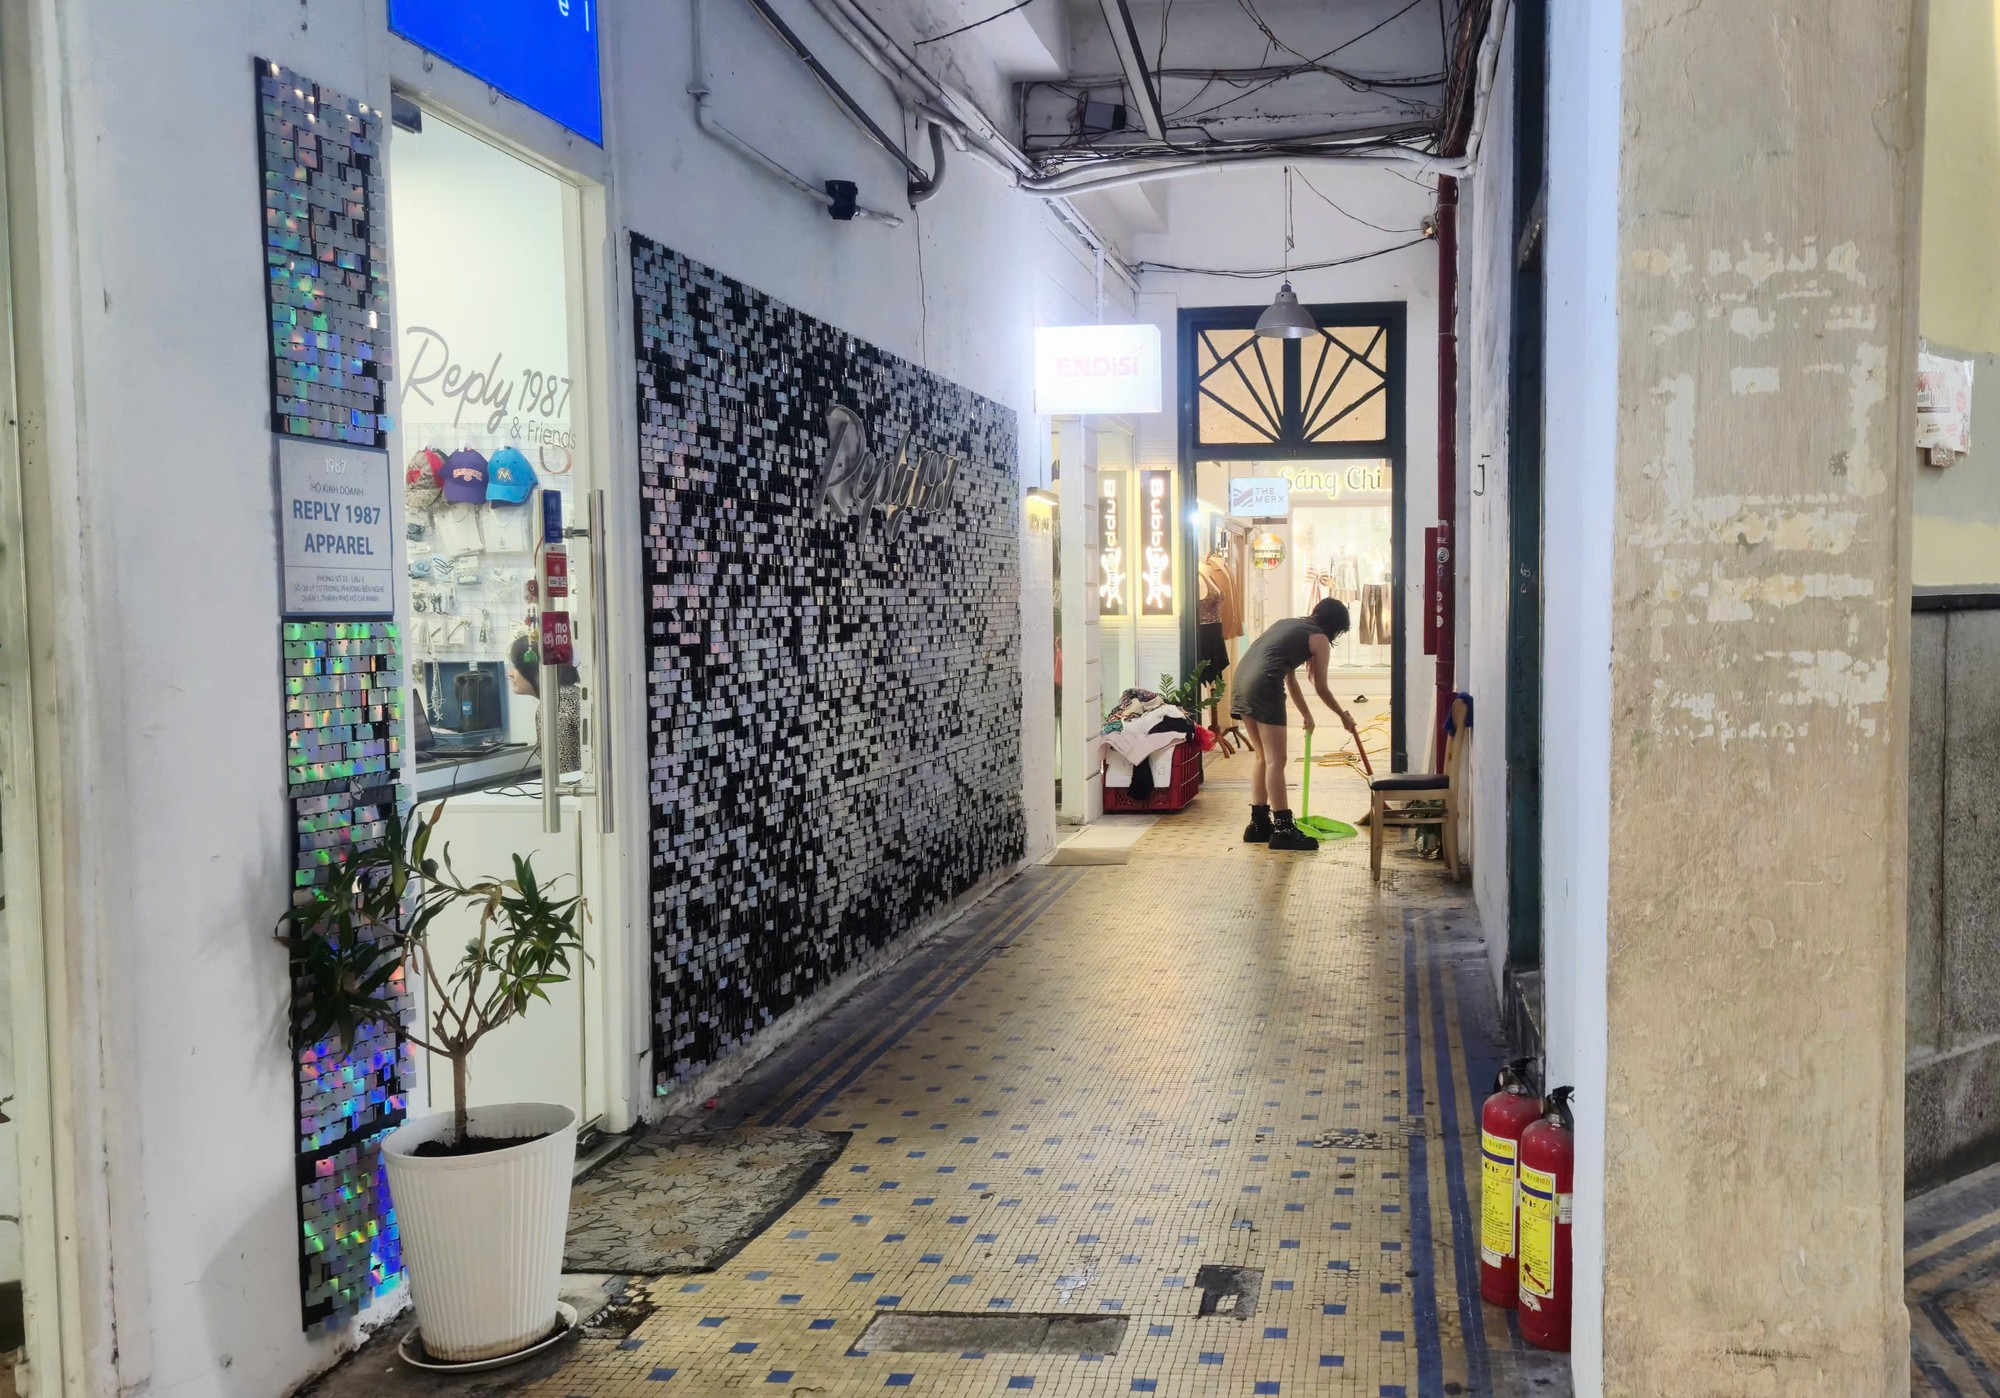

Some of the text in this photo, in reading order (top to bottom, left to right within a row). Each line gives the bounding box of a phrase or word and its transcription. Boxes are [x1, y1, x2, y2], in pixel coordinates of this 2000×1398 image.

[401, 326, 574, 434] Reply 1987
[510, 416, 576, 449] & Friends
[815, 404, 915, 545] Reply
[1281, 466, 1381, 497] Sáng Chi
[322, 483, 339, 494] KINH
[340, 485, 364, 496] DOANH
[1255, 487, 1275, 495] THE
[293, 499, 380, 525] REPLY 1987
[304, 533, 373, 555] APPAREL
